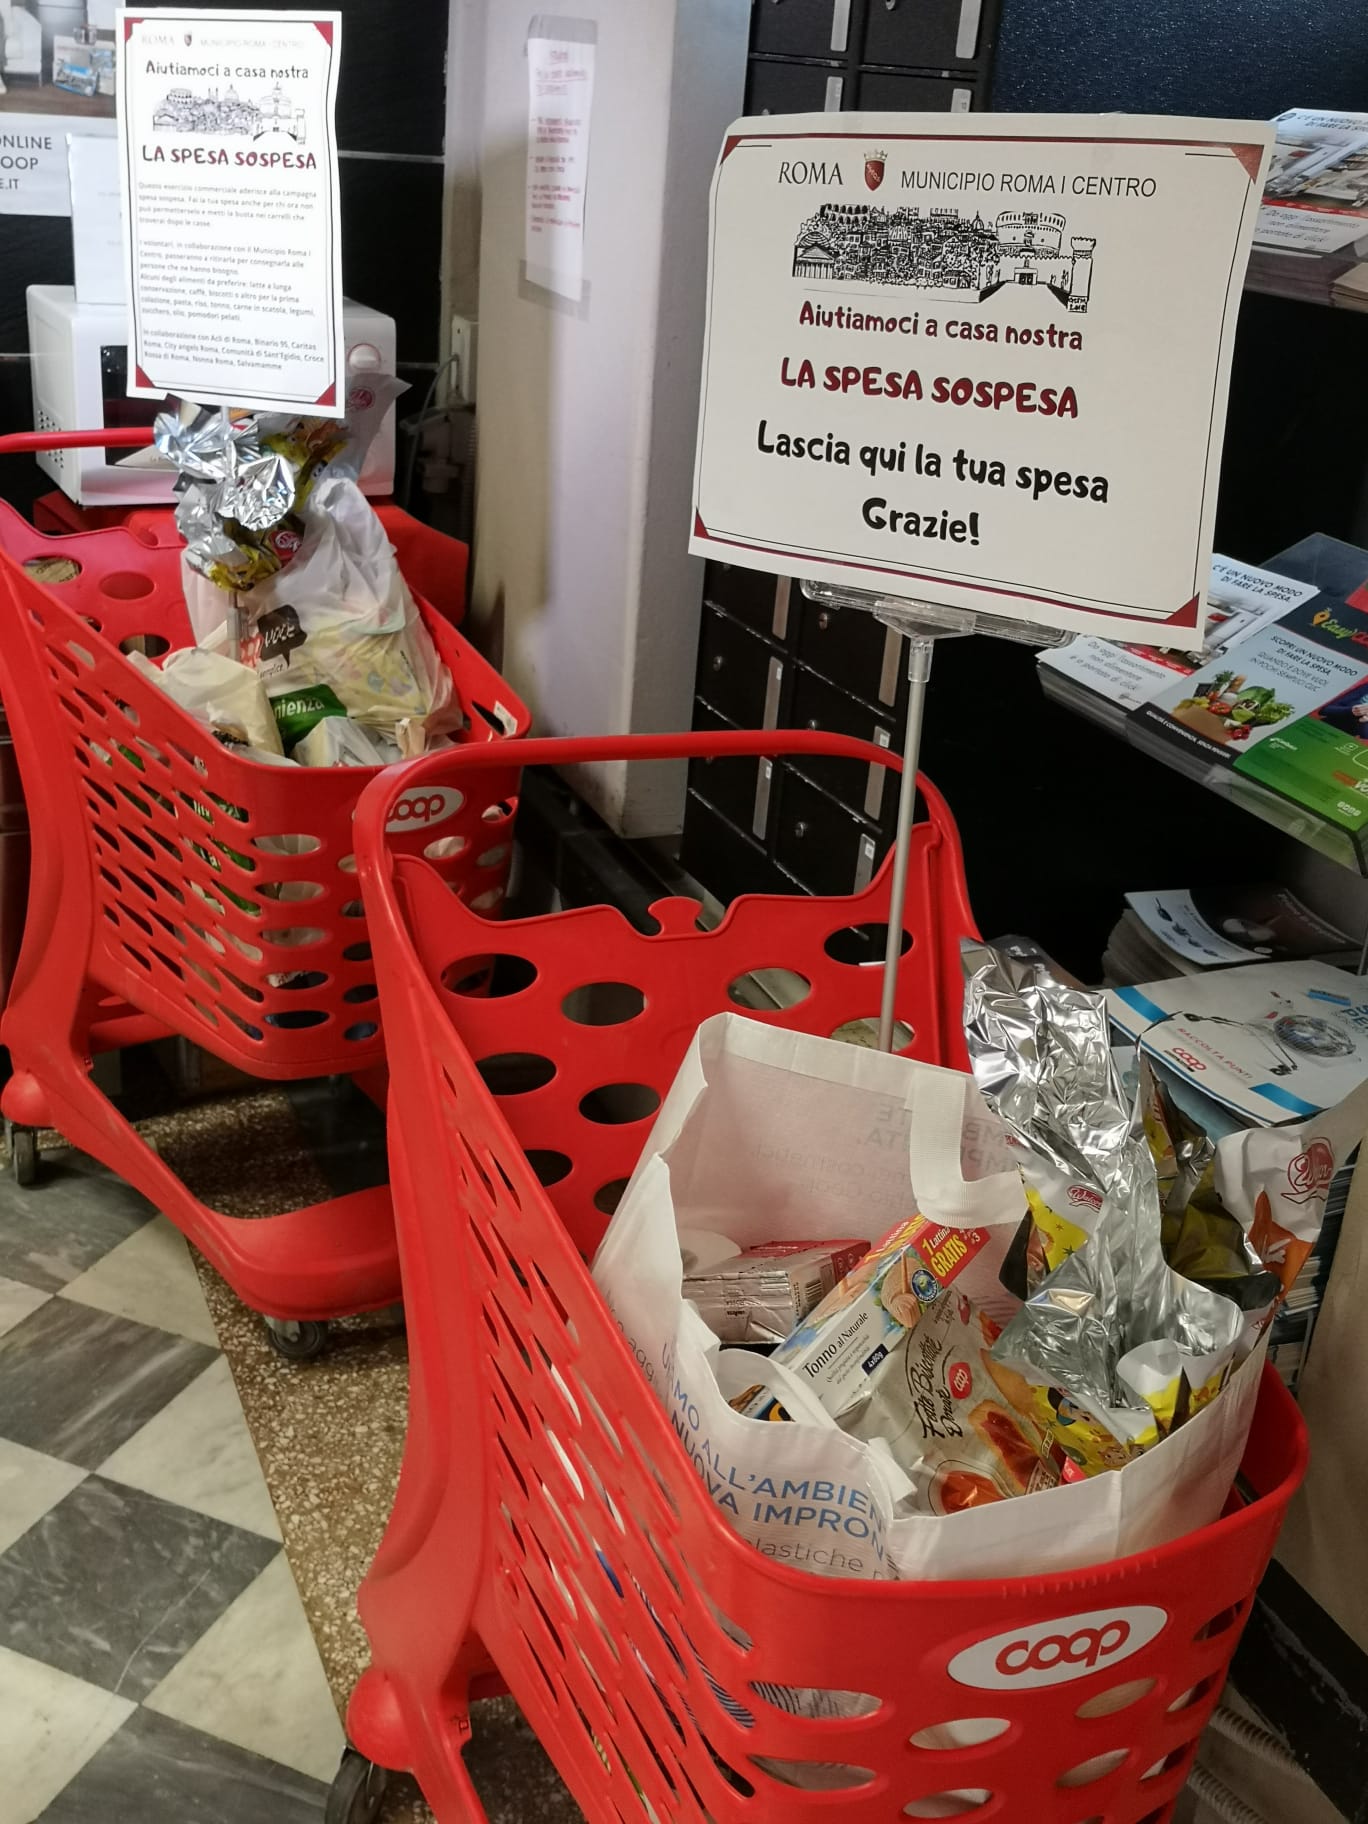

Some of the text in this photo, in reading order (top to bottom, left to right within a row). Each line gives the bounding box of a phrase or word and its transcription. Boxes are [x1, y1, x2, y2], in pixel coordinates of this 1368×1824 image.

[146, 60, 309, 79] Aiutiamoci a casa nostra
[0, 156, 39, 170] OOP
[142, 145, 317, 169] LA SPESA SOSPESA
[778, 160, 844, 187] ROMA
[900, 171, 995, 193] MUNICIPIO
[1000, 174, 1057, 195] ROMA
[1060, 175, 1066, 196] I
[1071, 175, 1157, 198] CENTRO
[799, 300, 1083, 351] Aiutiamoci a casa nostra
[780, 357, 1079, 419] LA SPESA SOSPESA
[757, 419, 1110, 503] Lascia qui la tua spesa
[861, 497, 980, 546] Grazie!
[274, 699, 325, 719] nienza
[1172, 1047, 1207, 1070] coop
[922, 1238, 933, 1256] 1
[930, 1234, 968, 1277] GRATIS
[802, 1343, 838, 1379] Tonno
[837, 1336, 846, 1348] al
[843, 1311, 869, 1338] Naturale
[910, 1333, 943, 1396] Biscottate
[953, 1368, 969, 1392] coop
[914, 1393, 945, 1439] Fette
[935, 1384, 964, 1438] Dorate
[671, 1410, 884, 1562] NUOVA IMPRON
[701, 1439, 886, 1532] ALL'AMBIEN
[744, 1537, 864, 1573] lastiche
[995, 1620, 1131, 1676] coop
